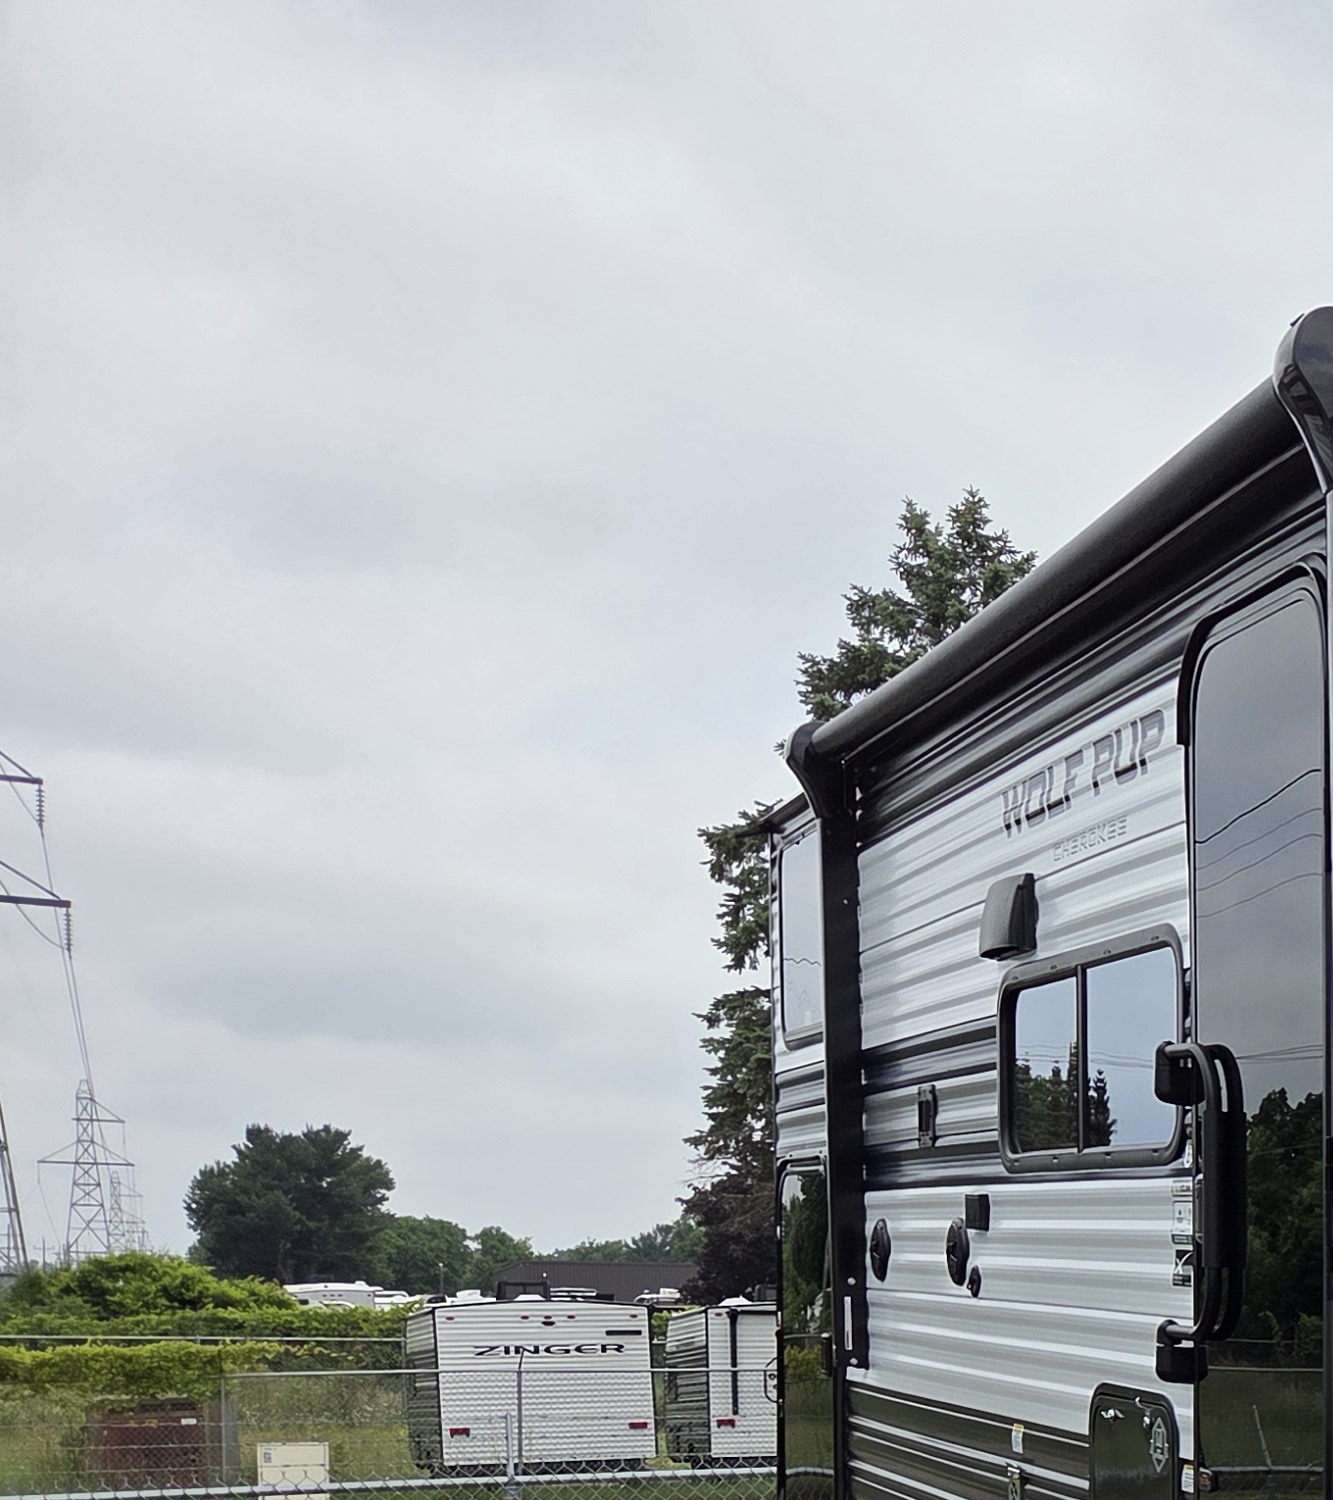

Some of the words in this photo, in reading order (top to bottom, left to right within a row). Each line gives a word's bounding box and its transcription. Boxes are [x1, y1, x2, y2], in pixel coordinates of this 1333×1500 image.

[1002, 748, 1084, 839] WOLF
[1092, 709, 1166, 797] PUP
[1052, 815, 1128, 862] CHEROKEE
[474, 1343, 626, 1357] ZINGER
